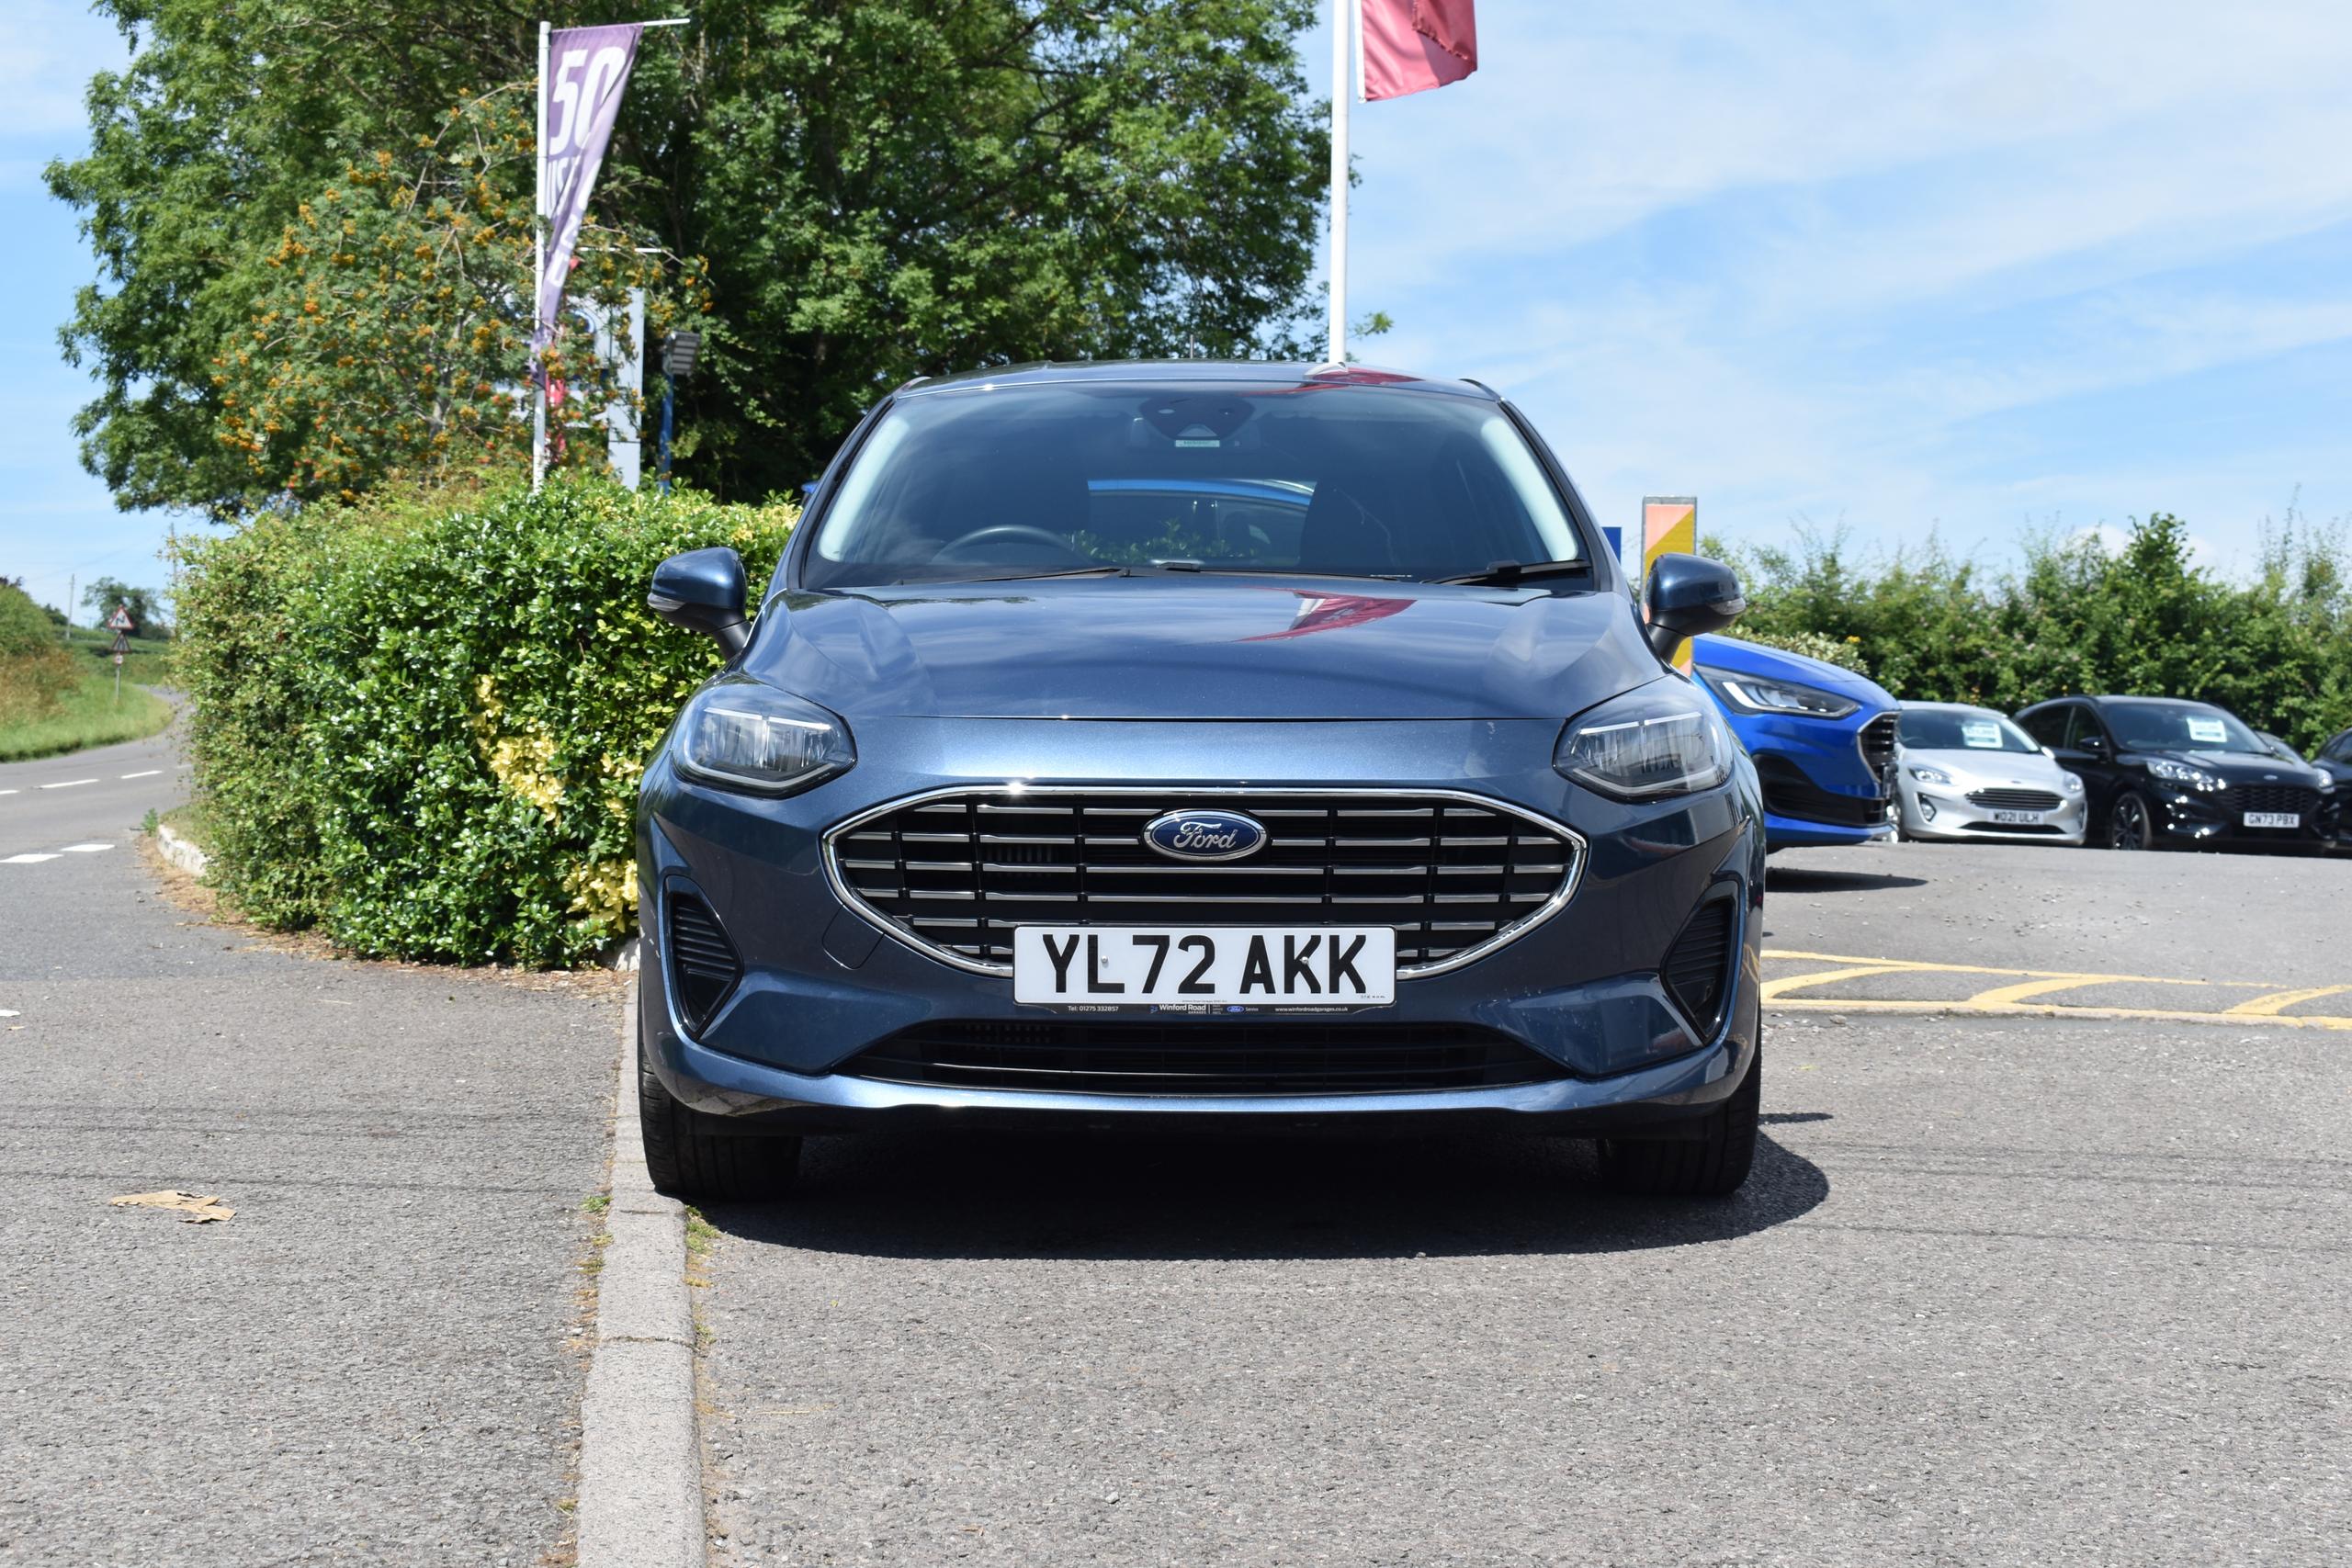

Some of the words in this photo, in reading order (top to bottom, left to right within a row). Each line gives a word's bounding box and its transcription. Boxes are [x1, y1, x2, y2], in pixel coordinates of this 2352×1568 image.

[549, 46, 627, 156] 50
[1173, 821, 1238, 849] Ford
[2249, 814, 2274, 825] GN73
[1042, 934, 1216, 994] YL72
[1239, 934, 1366, 994] AKK
